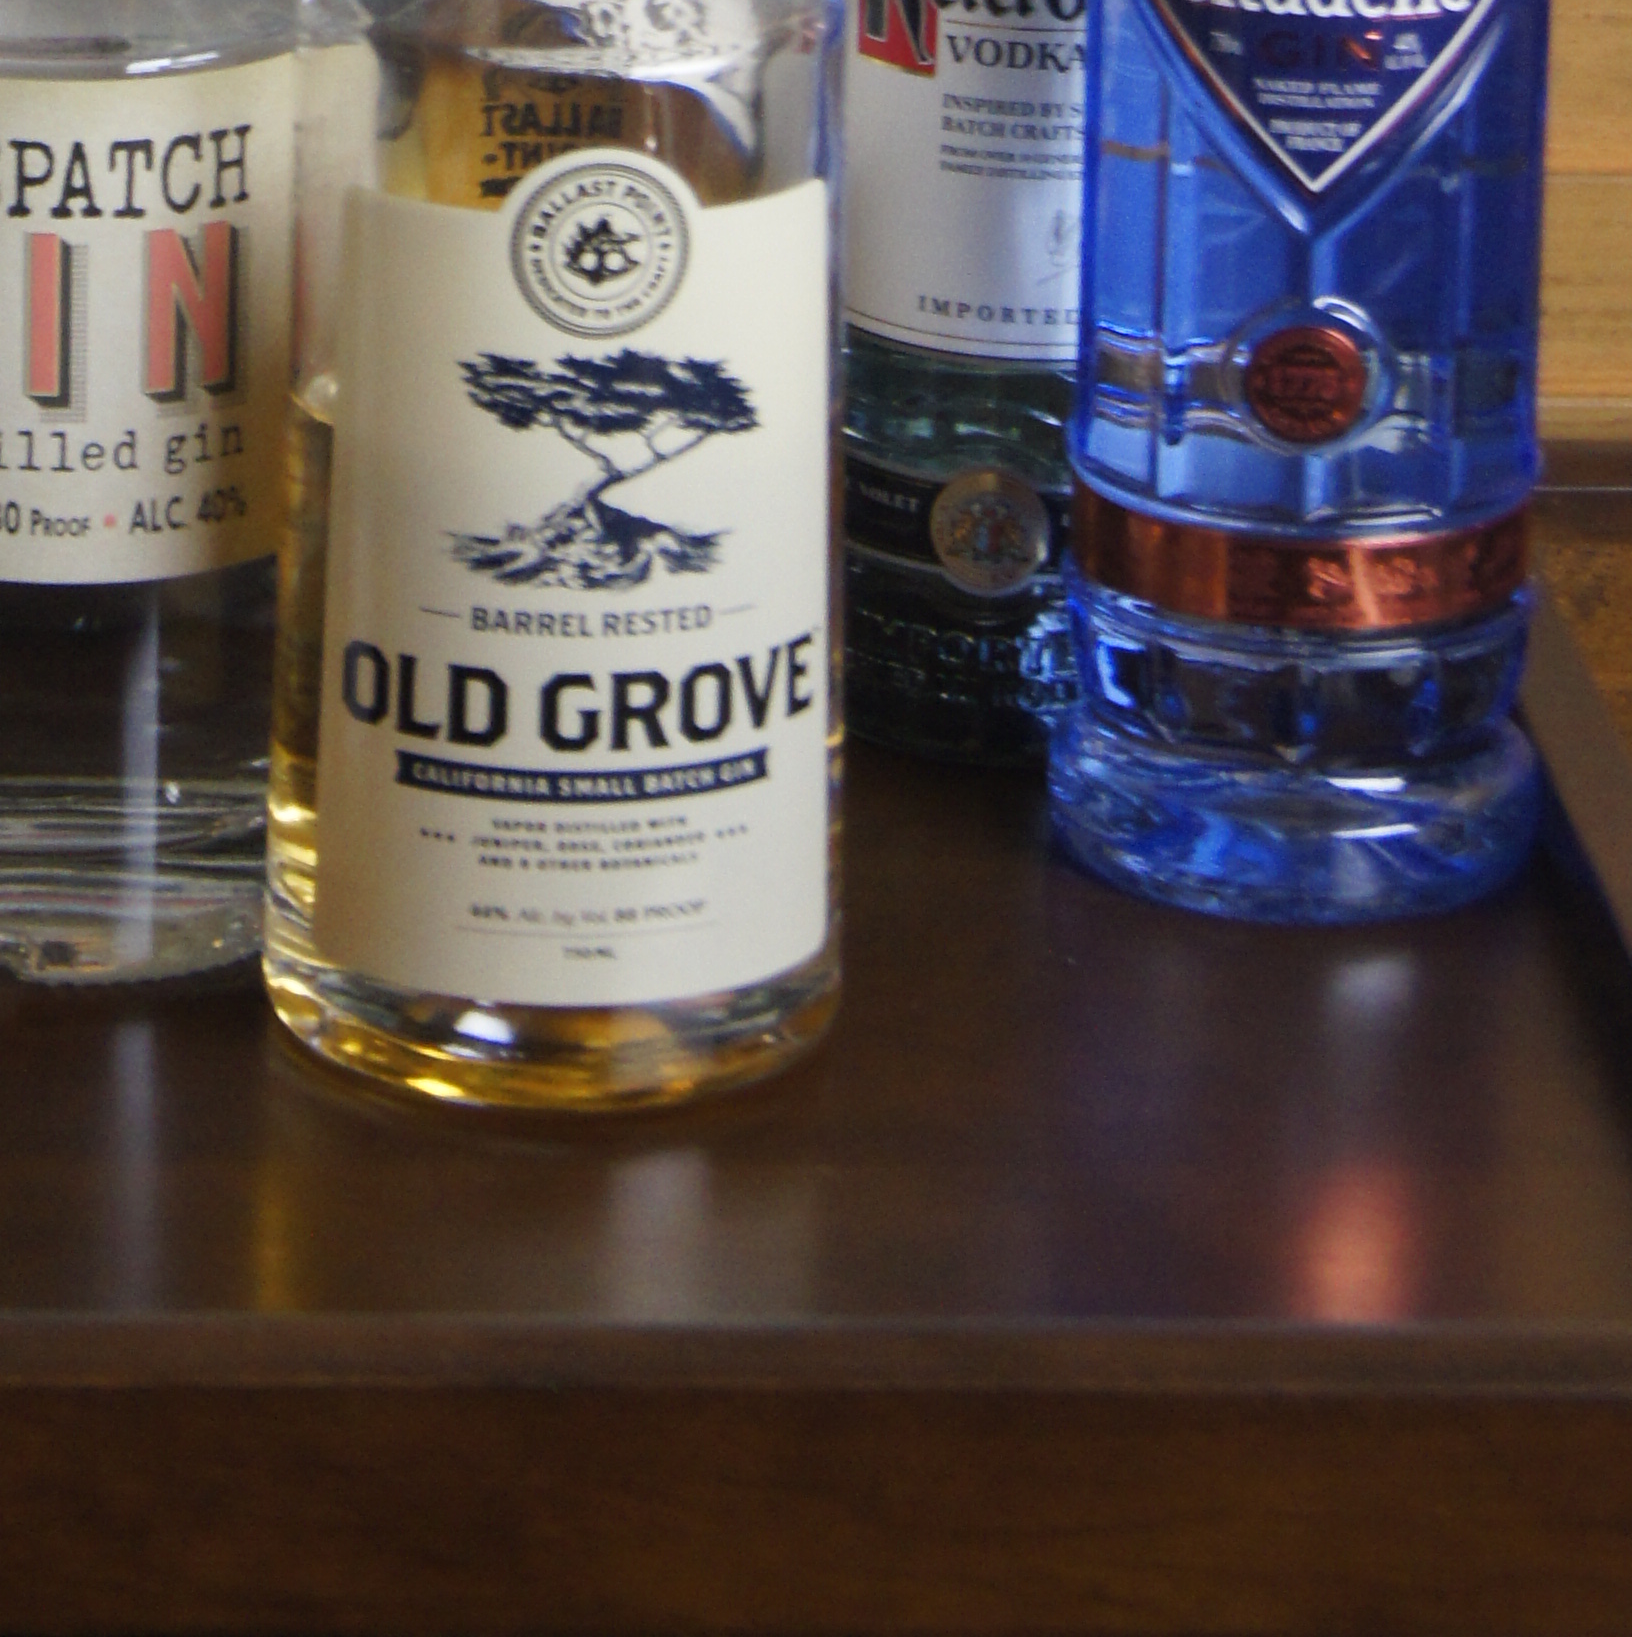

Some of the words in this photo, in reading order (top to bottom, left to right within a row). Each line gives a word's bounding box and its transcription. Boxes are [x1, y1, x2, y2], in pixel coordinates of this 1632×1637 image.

[163, 425, 246, 475] gin
[129, 496, 186, 535] ALC
[471, 605, 596, 638] BARREL
[601, 603, 713, 637] RESTED
[341, 639, 508, 749] OLD
[538, 632, 814, 752] GROVE
[410, 762, 551, 796] CALIFORNIA
[557, 775, 636, 797] SMALL
